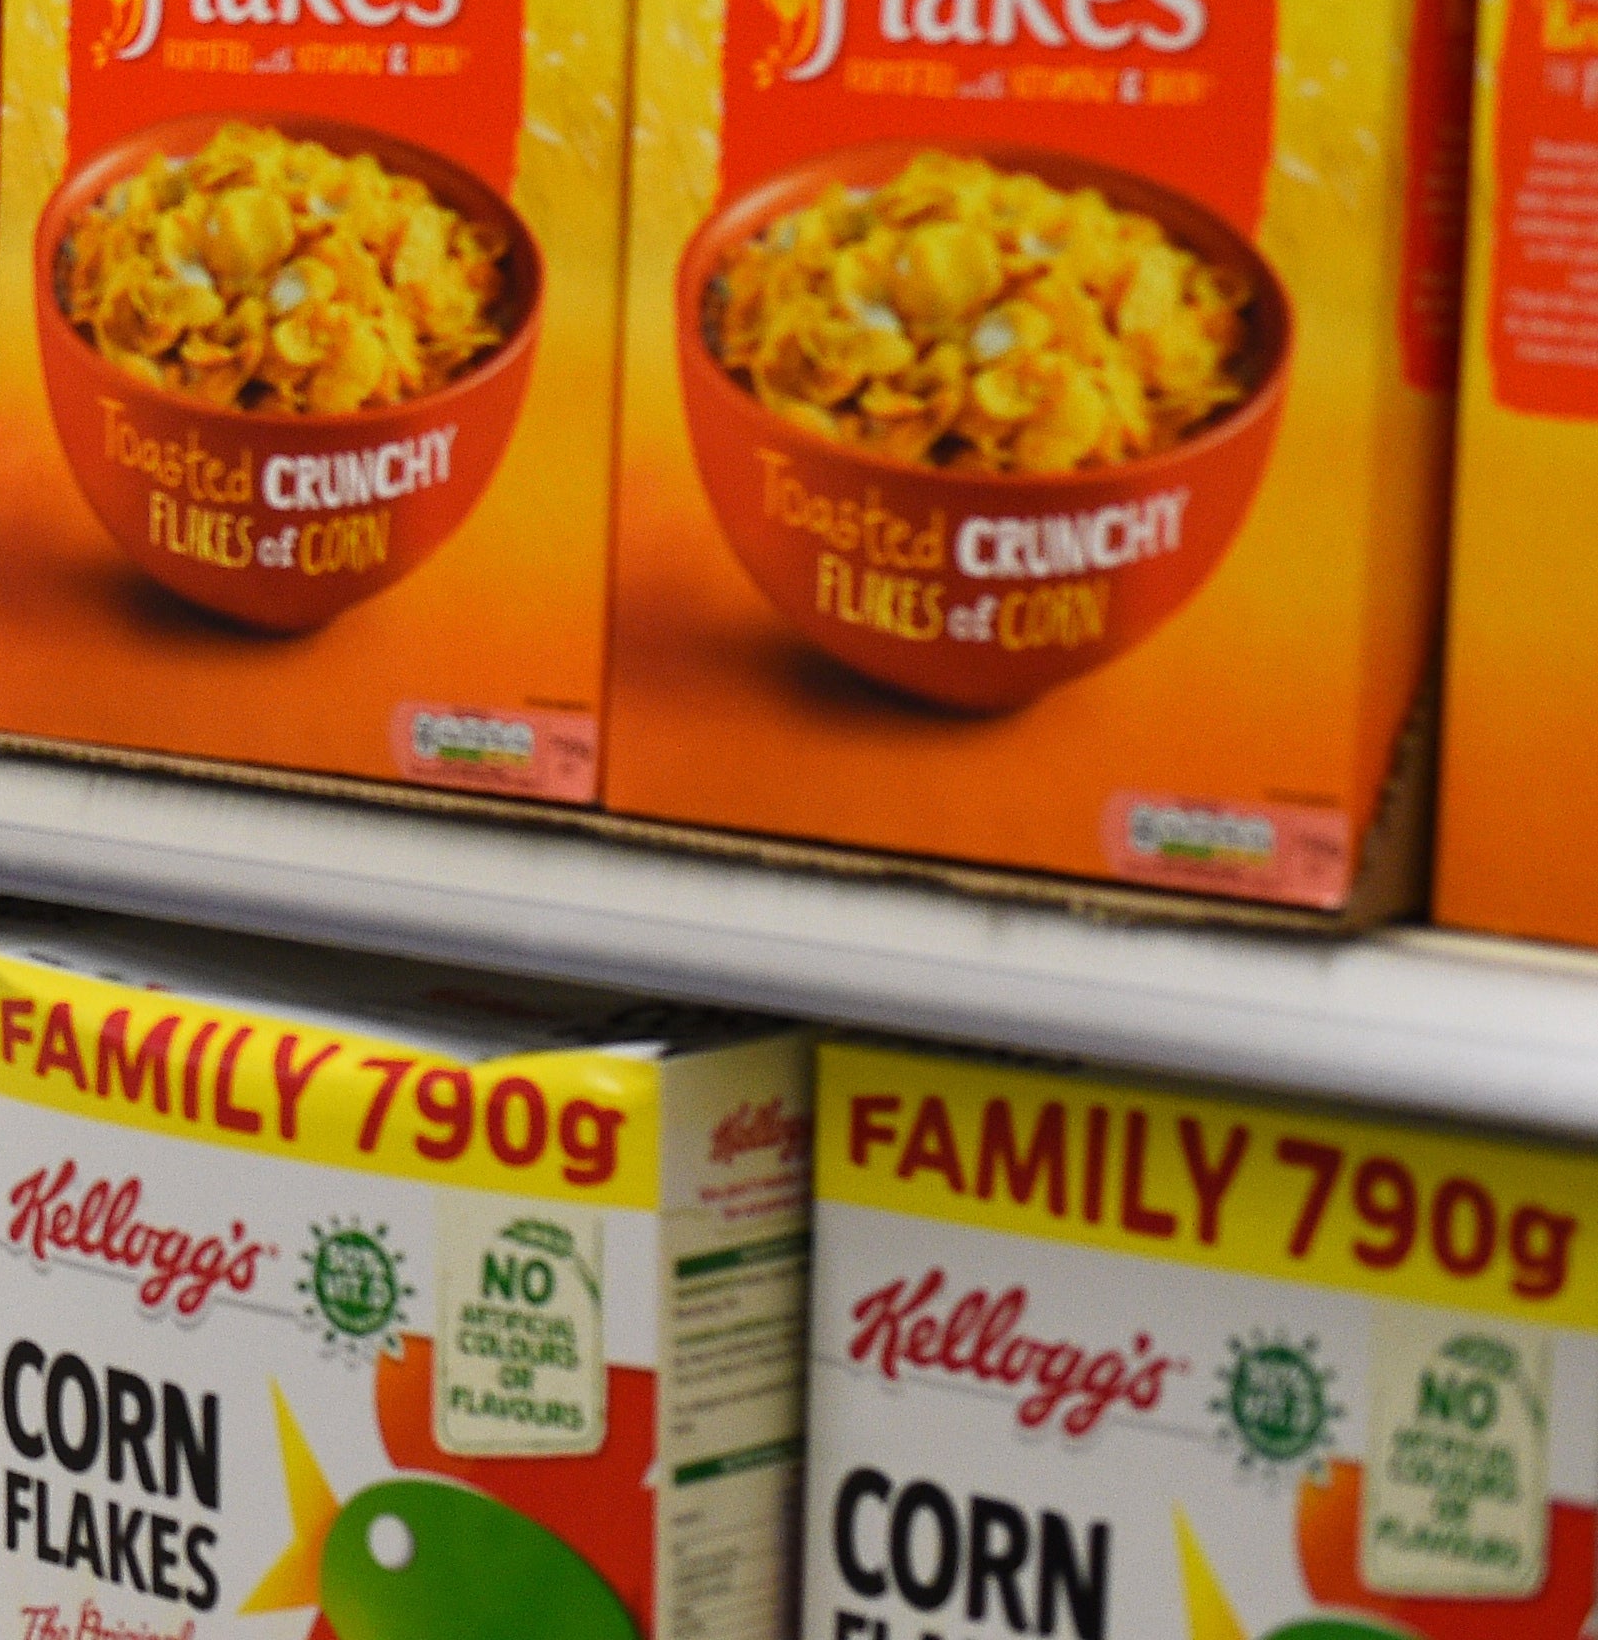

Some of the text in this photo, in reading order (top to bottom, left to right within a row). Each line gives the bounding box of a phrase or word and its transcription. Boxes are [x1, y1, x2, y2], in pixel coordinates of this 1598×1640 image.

[0, 998, 628, 1186] FAMILY 790g
[849, 1094, 1580, 1303] FAMILY 790g
[2, 1338, 221, 1512] CORN
[849, 1268, 1170, 1438] Kellogg's
